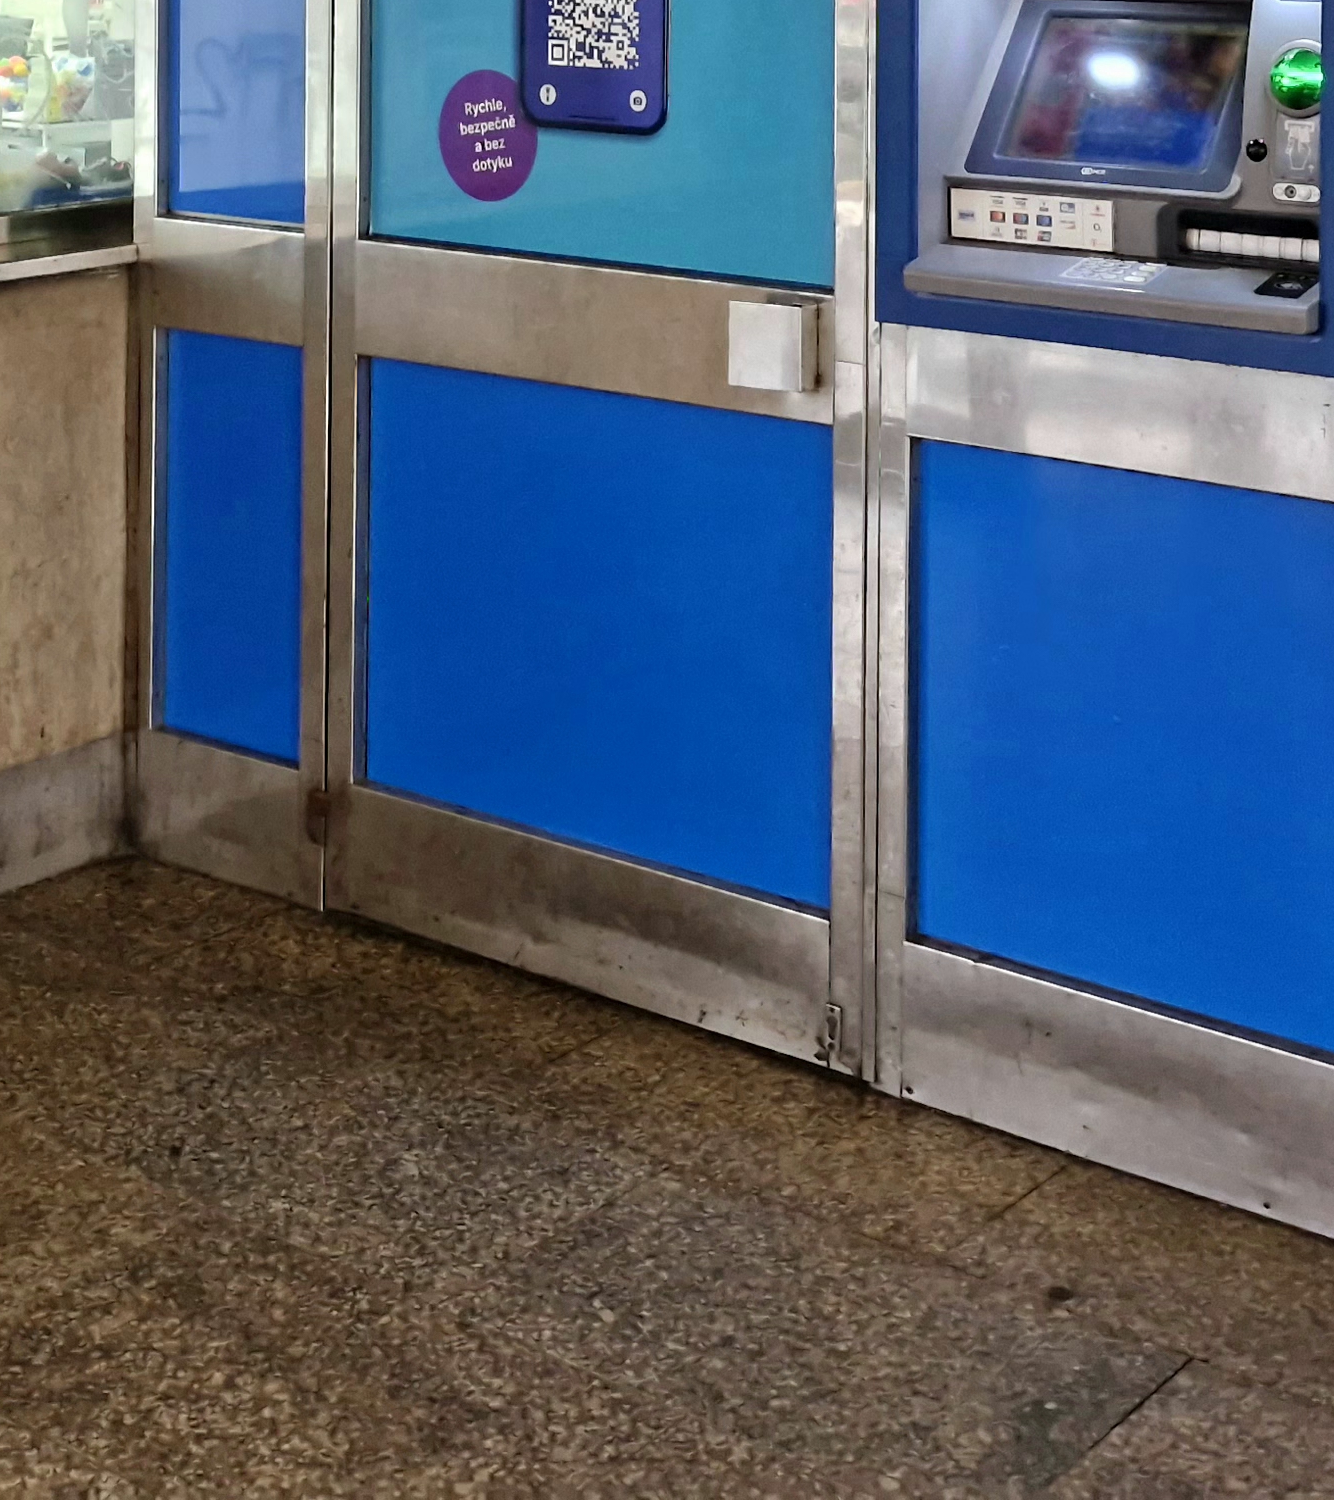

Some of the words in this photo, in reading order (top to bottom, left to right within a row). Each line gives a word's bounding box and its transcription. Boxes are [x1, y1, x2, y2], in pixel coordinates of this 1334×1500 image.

[464, 97, 507, 118] Rychle,
[459, 114, 516, 136] bezpečně
[474, 141, 483, 153] a
[484, 138, 505, 151] bez
[472, 155, 513, 173] dotyku
